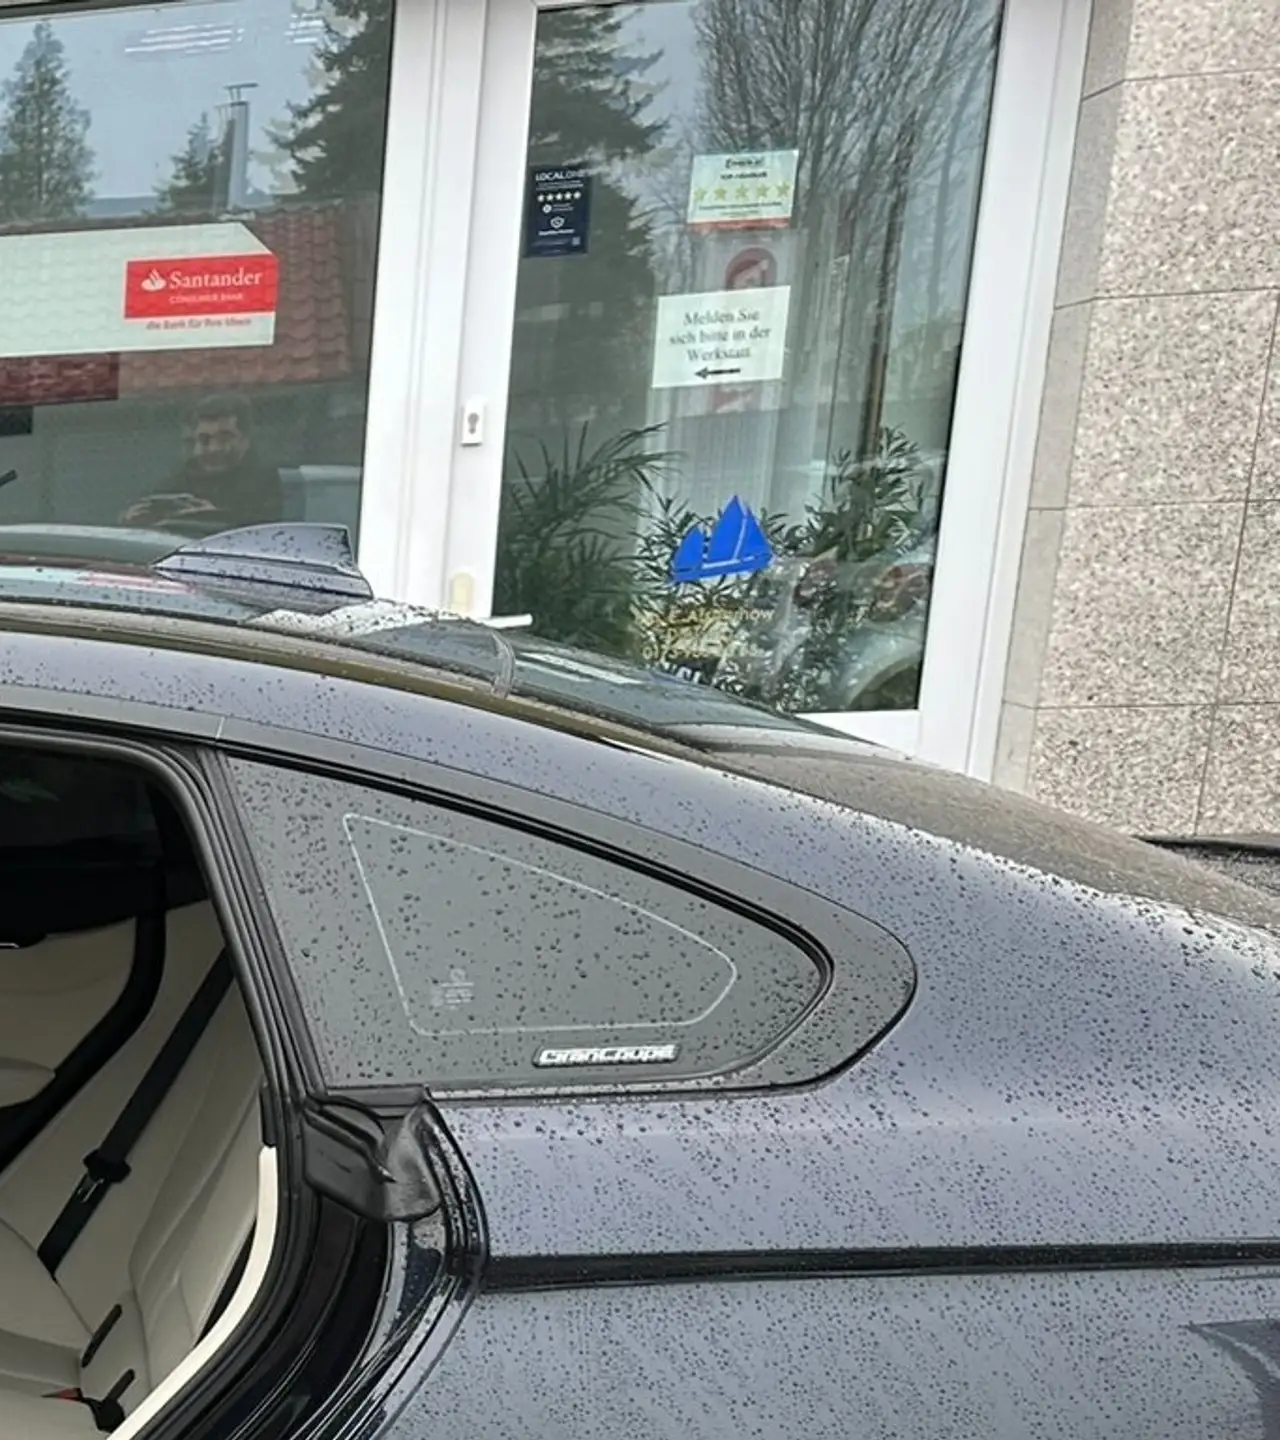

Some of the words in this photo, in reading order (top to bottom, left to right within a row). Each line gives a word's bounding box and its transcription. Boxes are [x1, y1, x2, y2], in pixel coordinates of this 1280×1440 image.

[168, 267, 264, 289] Santander
[683, 310, 735, 326] Melden
[737, 308, 760, 322] Sie
[669, 330, 697, 345] sich
[732, 329, 746, 341] in
[749, 325, 772, 339] der
